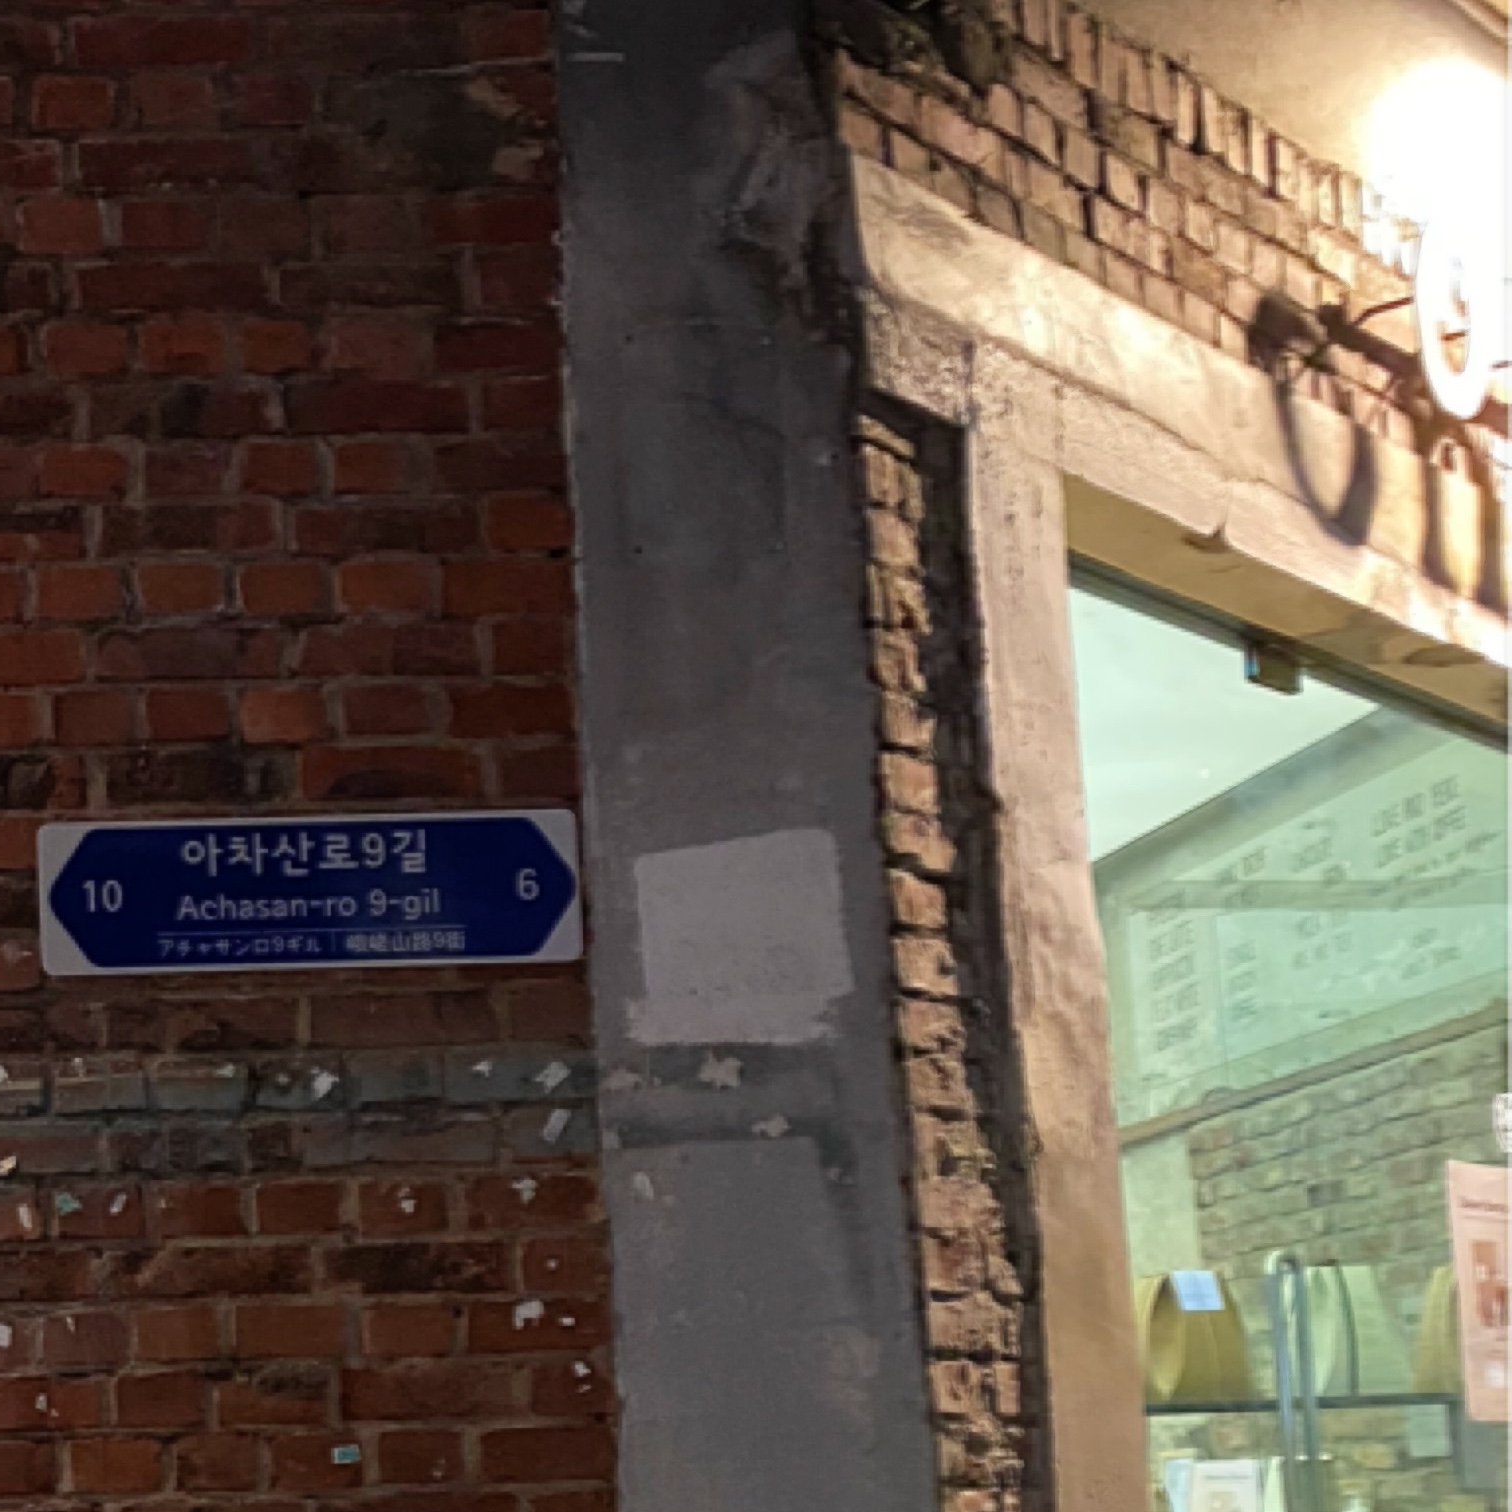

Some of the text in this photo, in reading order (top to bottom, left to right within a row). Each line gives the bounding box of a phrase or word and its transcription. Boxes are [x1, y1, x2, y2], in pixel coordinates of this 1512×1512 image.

[181, 829, 426, 876] 아차산로9길
[82, 880, 123, 912] 10
[518, 868, 540, 899] 6
[176, 888, 440, 920] Achasan-ro 9-gil
